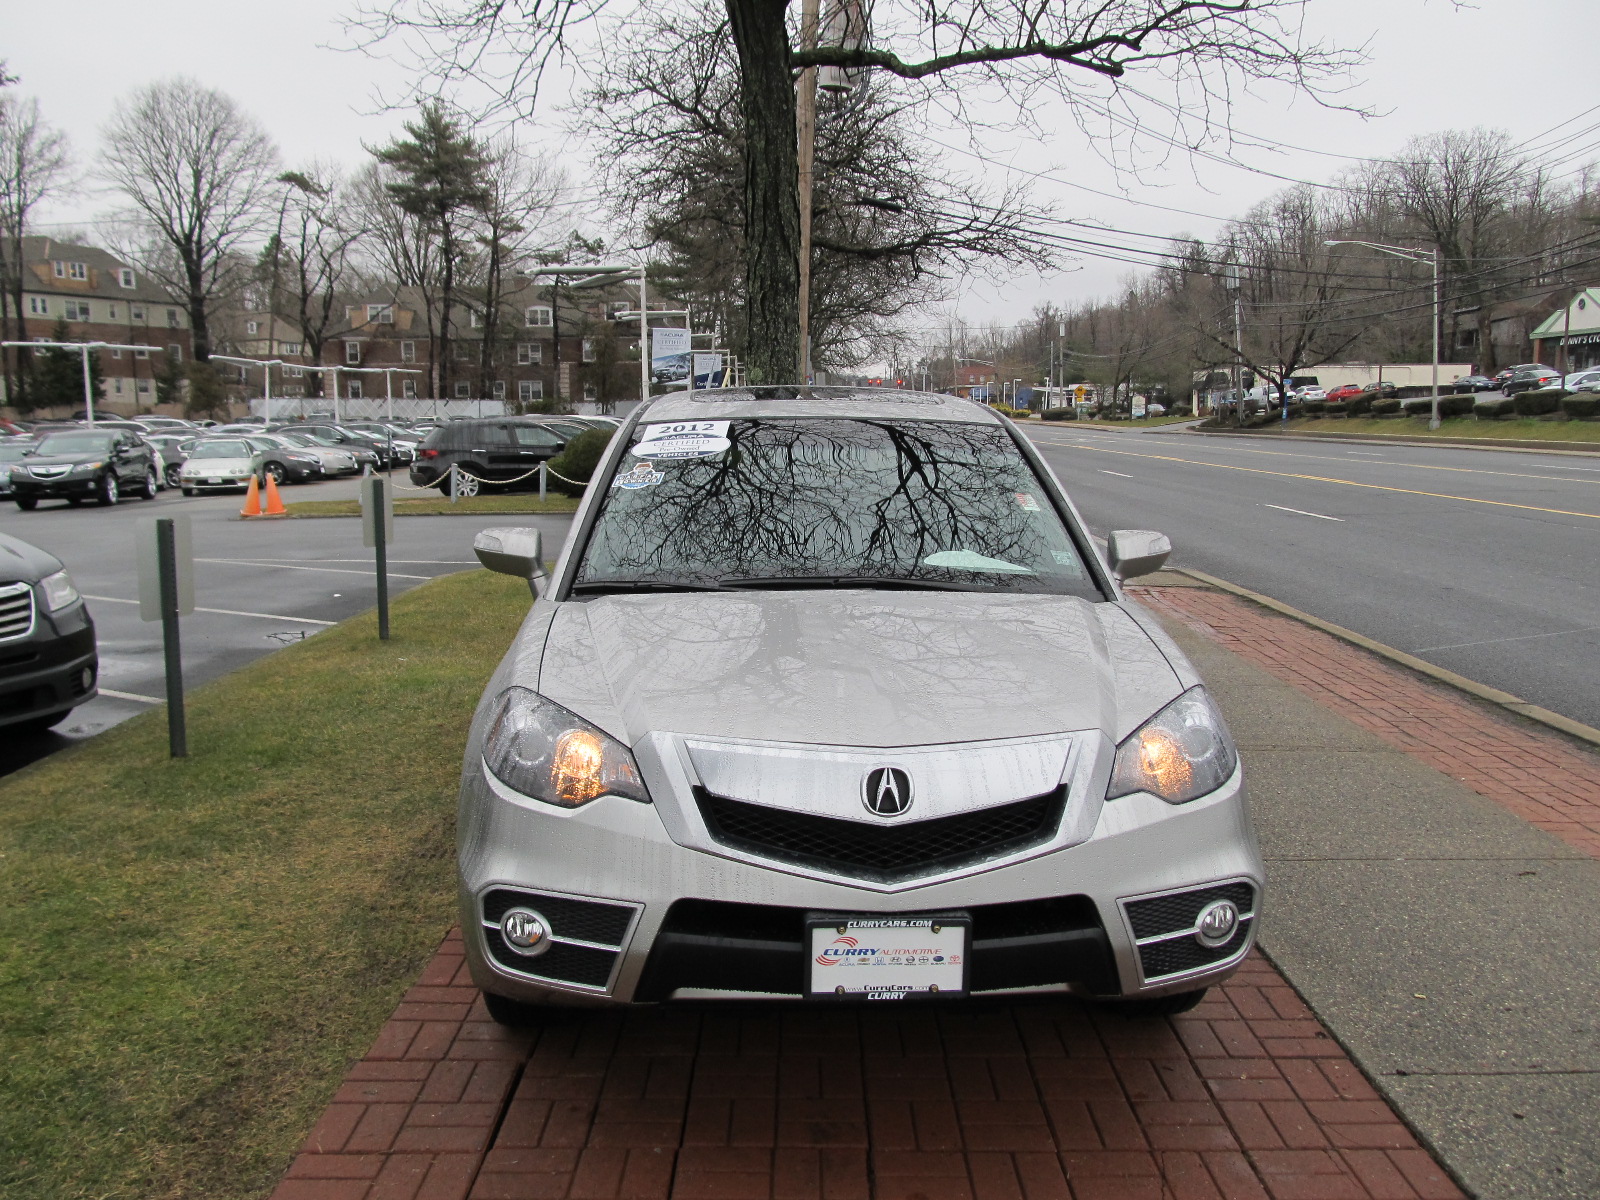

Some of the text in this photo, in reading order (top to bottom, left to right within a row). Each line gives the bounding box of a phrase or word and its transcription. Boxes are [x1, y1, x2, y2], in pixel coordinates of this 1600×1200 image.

[1560, 335, 1588, 346] DNNY'S
[658, 423, 715, 434] 2012
[653, 439, 710, 447] CERTIFIED
[847, 920, 933, 928] CURRYCARS.COM
[823, 948, 943, 956] CURRY AUTOMOTIVE
[867, 991, 907, 1000] CURRY
